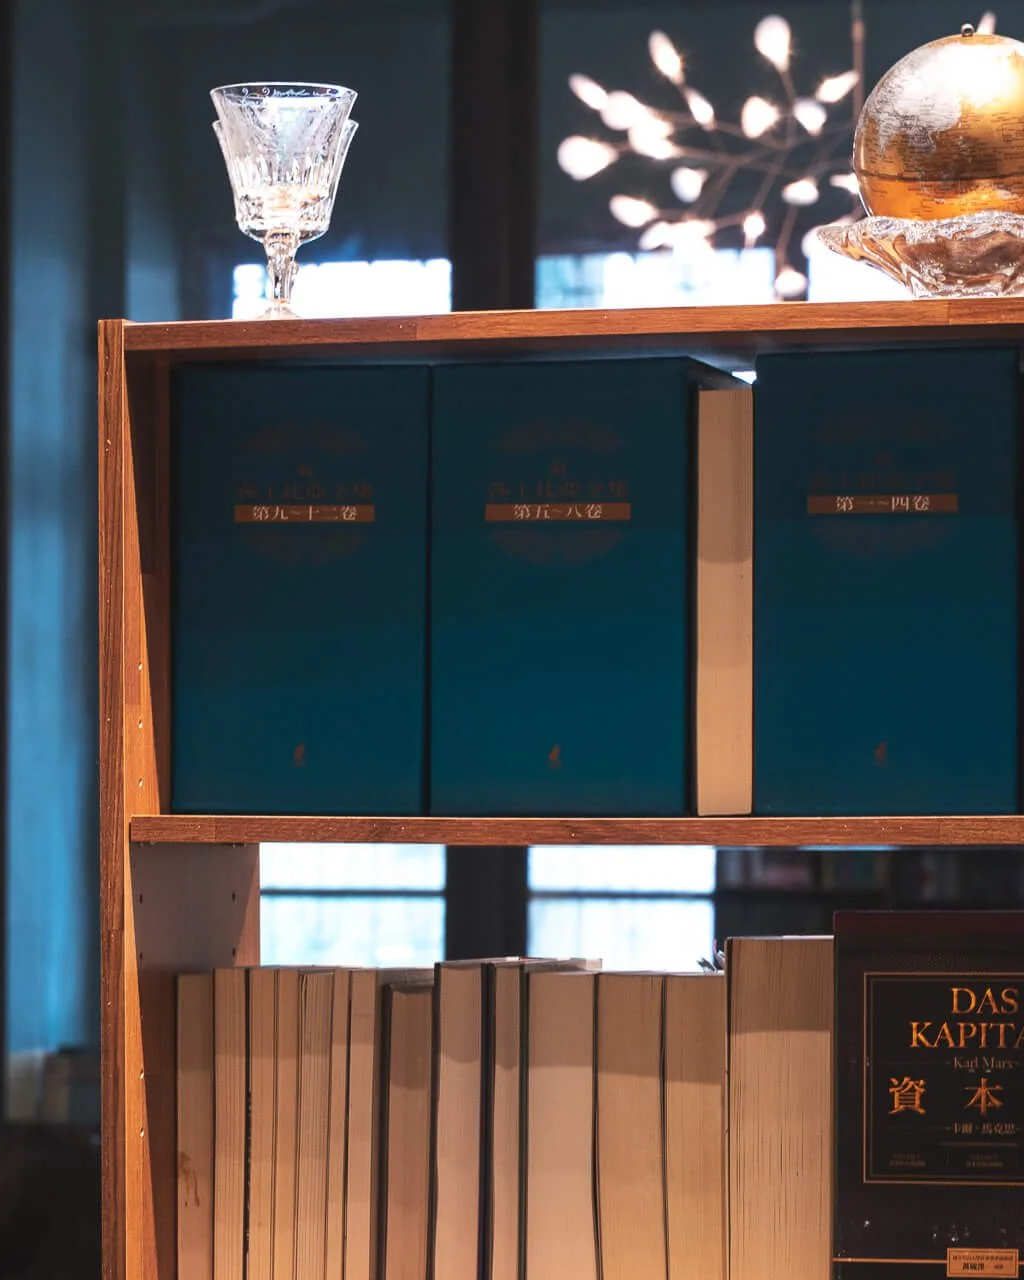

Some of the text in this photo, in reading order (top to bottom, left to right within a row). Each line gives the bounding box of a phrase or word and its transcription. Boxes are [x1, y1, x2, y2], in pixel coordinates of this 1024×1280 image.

[950, 987, 1019, 1015] DAS
[953, 1056, 1016, 1070] Karl Marx
